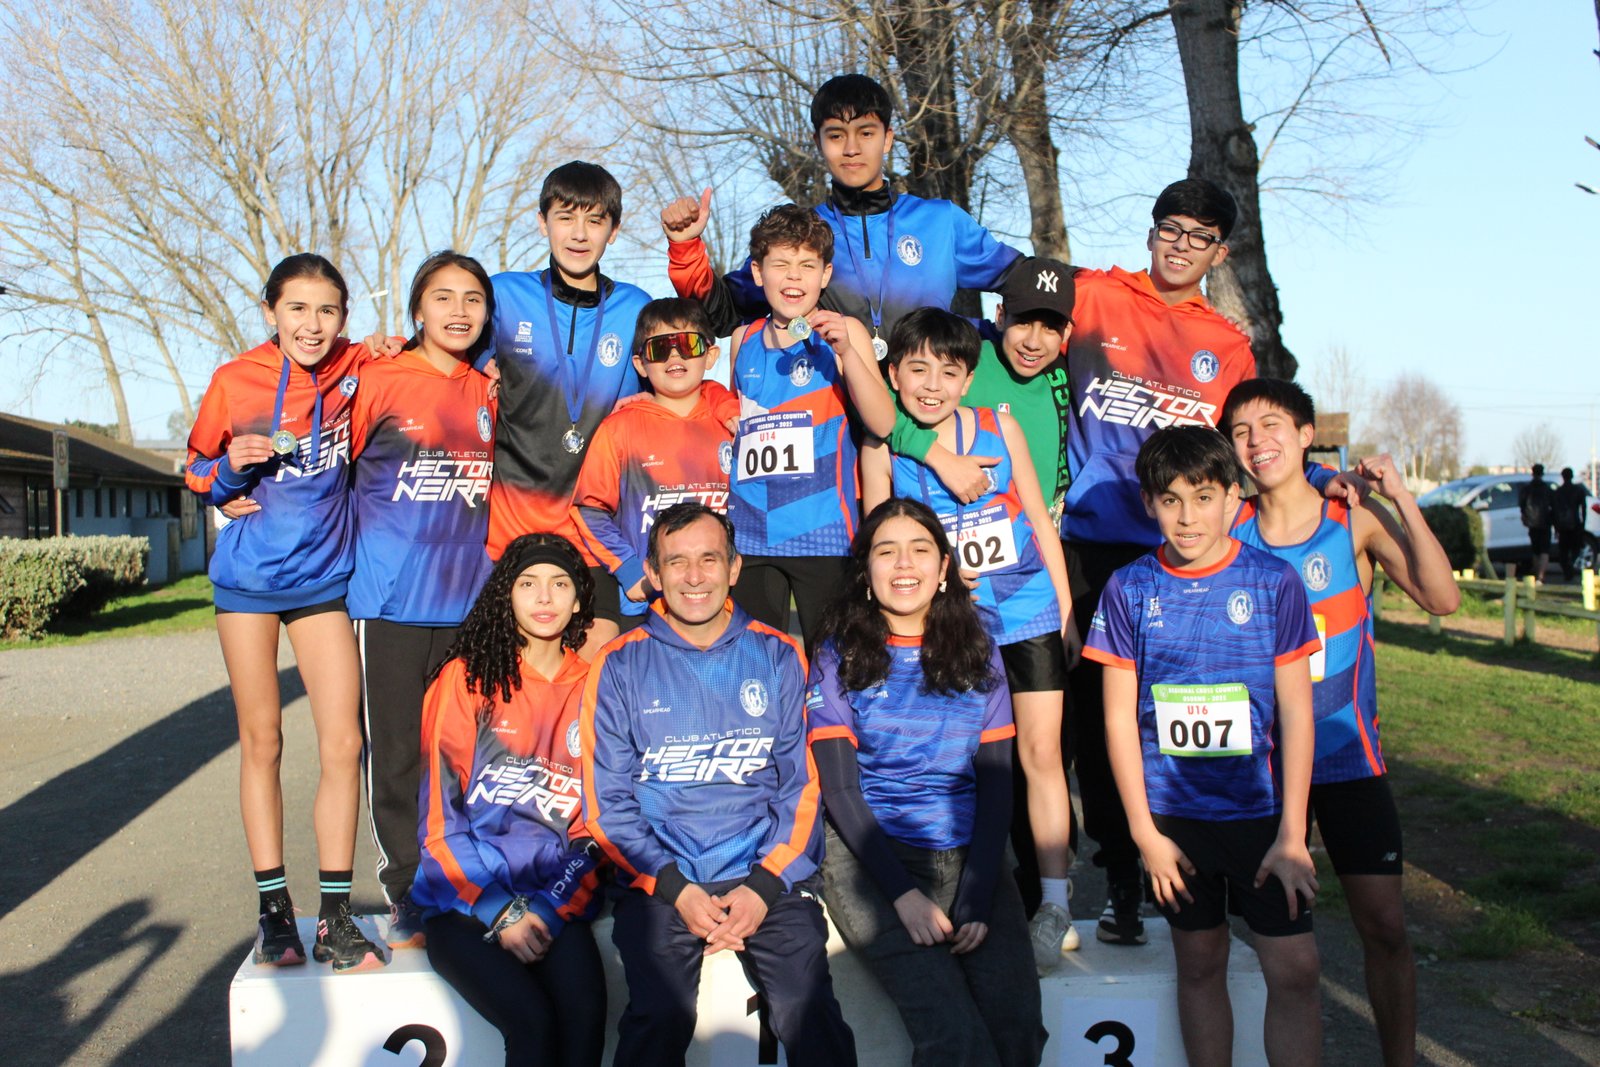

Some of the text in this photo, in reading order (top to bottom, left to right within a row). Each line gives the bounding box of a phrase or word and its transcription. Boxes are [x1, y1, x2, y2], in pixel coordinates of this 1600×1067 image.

[1036, 269, 1059, 293] NY
[1101, 342, 1127, 351] SPEARHEAD
[1112, 371, 1201, 398] CLUB ATLETICO
[1085, 377, 1217, 429] HECTOR
[760, 431, 776, 442] U14
[275, 438, 350, 482] NEIR
[418, 450, 444, 458] CLUB
[746, 444, 799, 476] 001
[397, 460, 494, 481] HECTOR
[391, 478, 491, 508] NEIRA
[641, 491, 729, 512] HECTO
[658, 484, 685, 492] CLUB
[963, 511, 979, 520] CROSS
[981, 505, 1003, 516] COUNTRY
[963, 536, 1004, 568] 02
[1187, 705, 1208, 715] U16
[702, 727, 761, 741] ATLETICO
[1170, 719, 1233, 749] 007
[641, 737, 775, 765] HECTOR
[536, 756, 573, 774] ATLETICO
[477, 764, 581, 797] HECTOR
[466, 781, 580, 822] NEIRA
[382, 1023, 447, 1067] 2
[1084, 1020, 1135, 1067] 3
